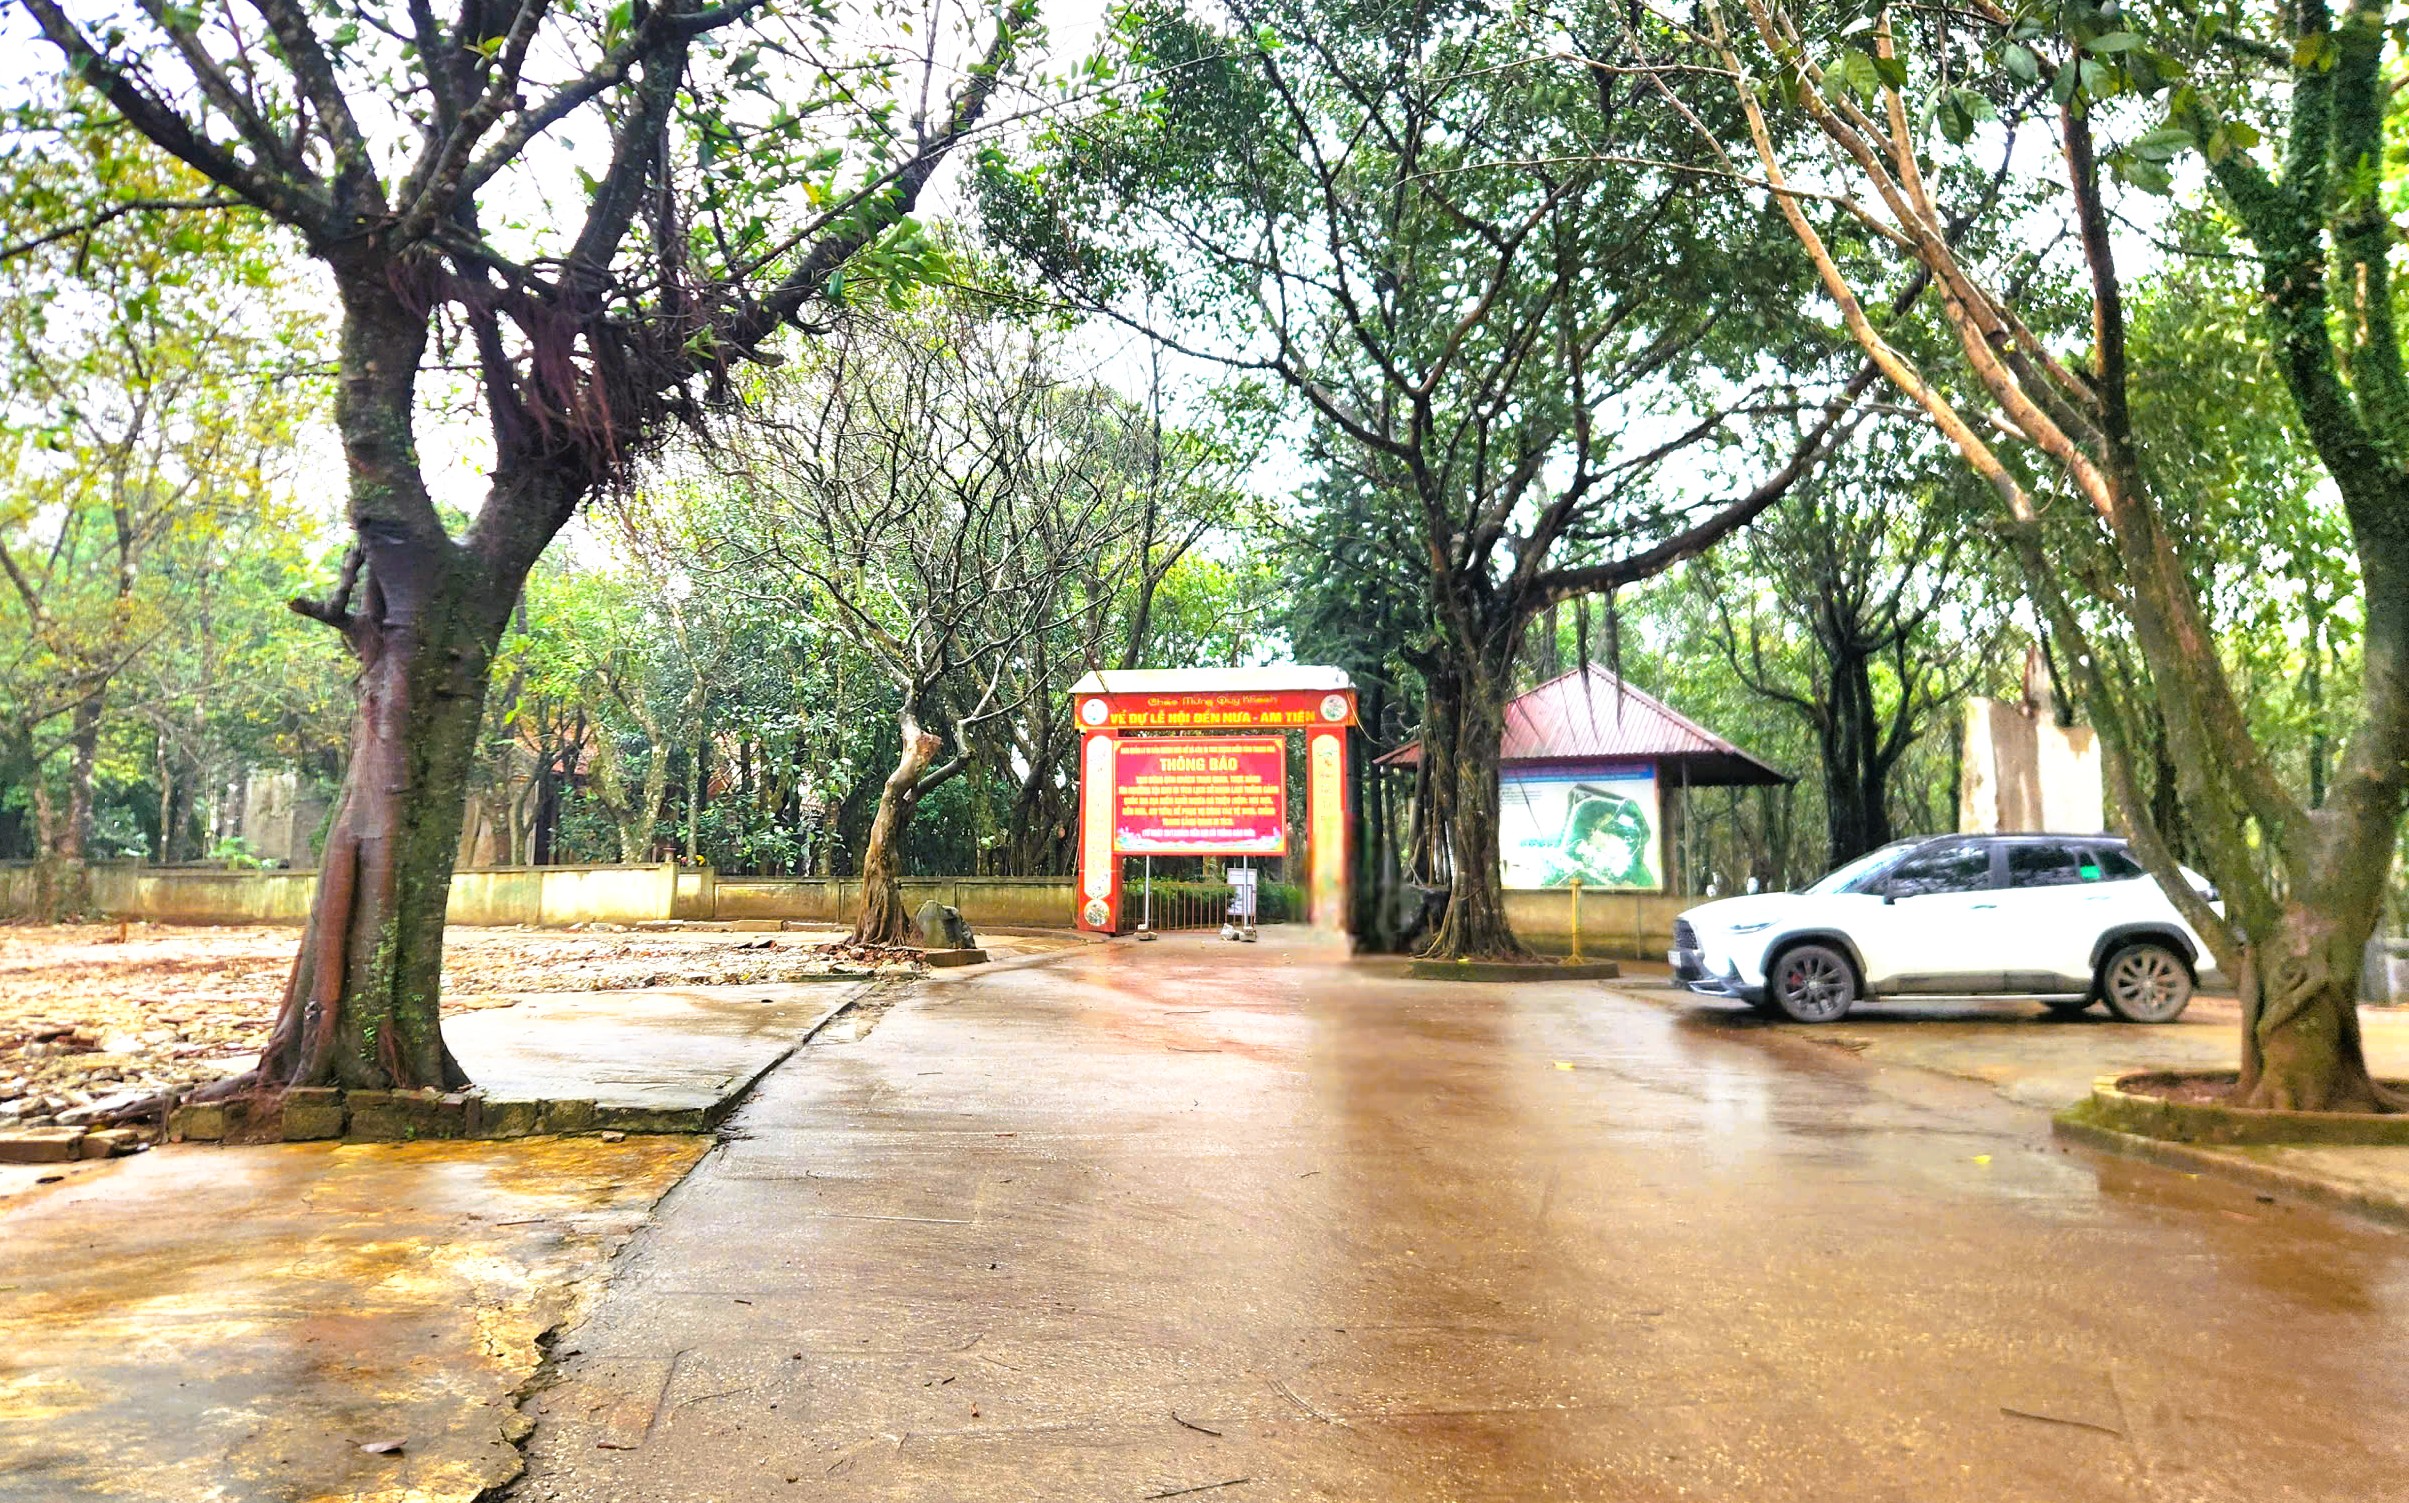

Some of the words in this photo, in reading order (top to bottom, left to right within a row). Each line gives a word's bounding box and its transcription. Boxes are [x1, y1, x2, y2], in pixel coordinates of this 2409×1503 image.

[1168, 710, 1191, 726] HỘI
[1222, 711, 1251, 723] NƯA
[1260, 711, 1282, 723] AM
[1285, 709, 1316, 723] TIÊN
[1159, 756, 1205, 772] THÔNG
[1209, 755, 1238, 771] BÁO
